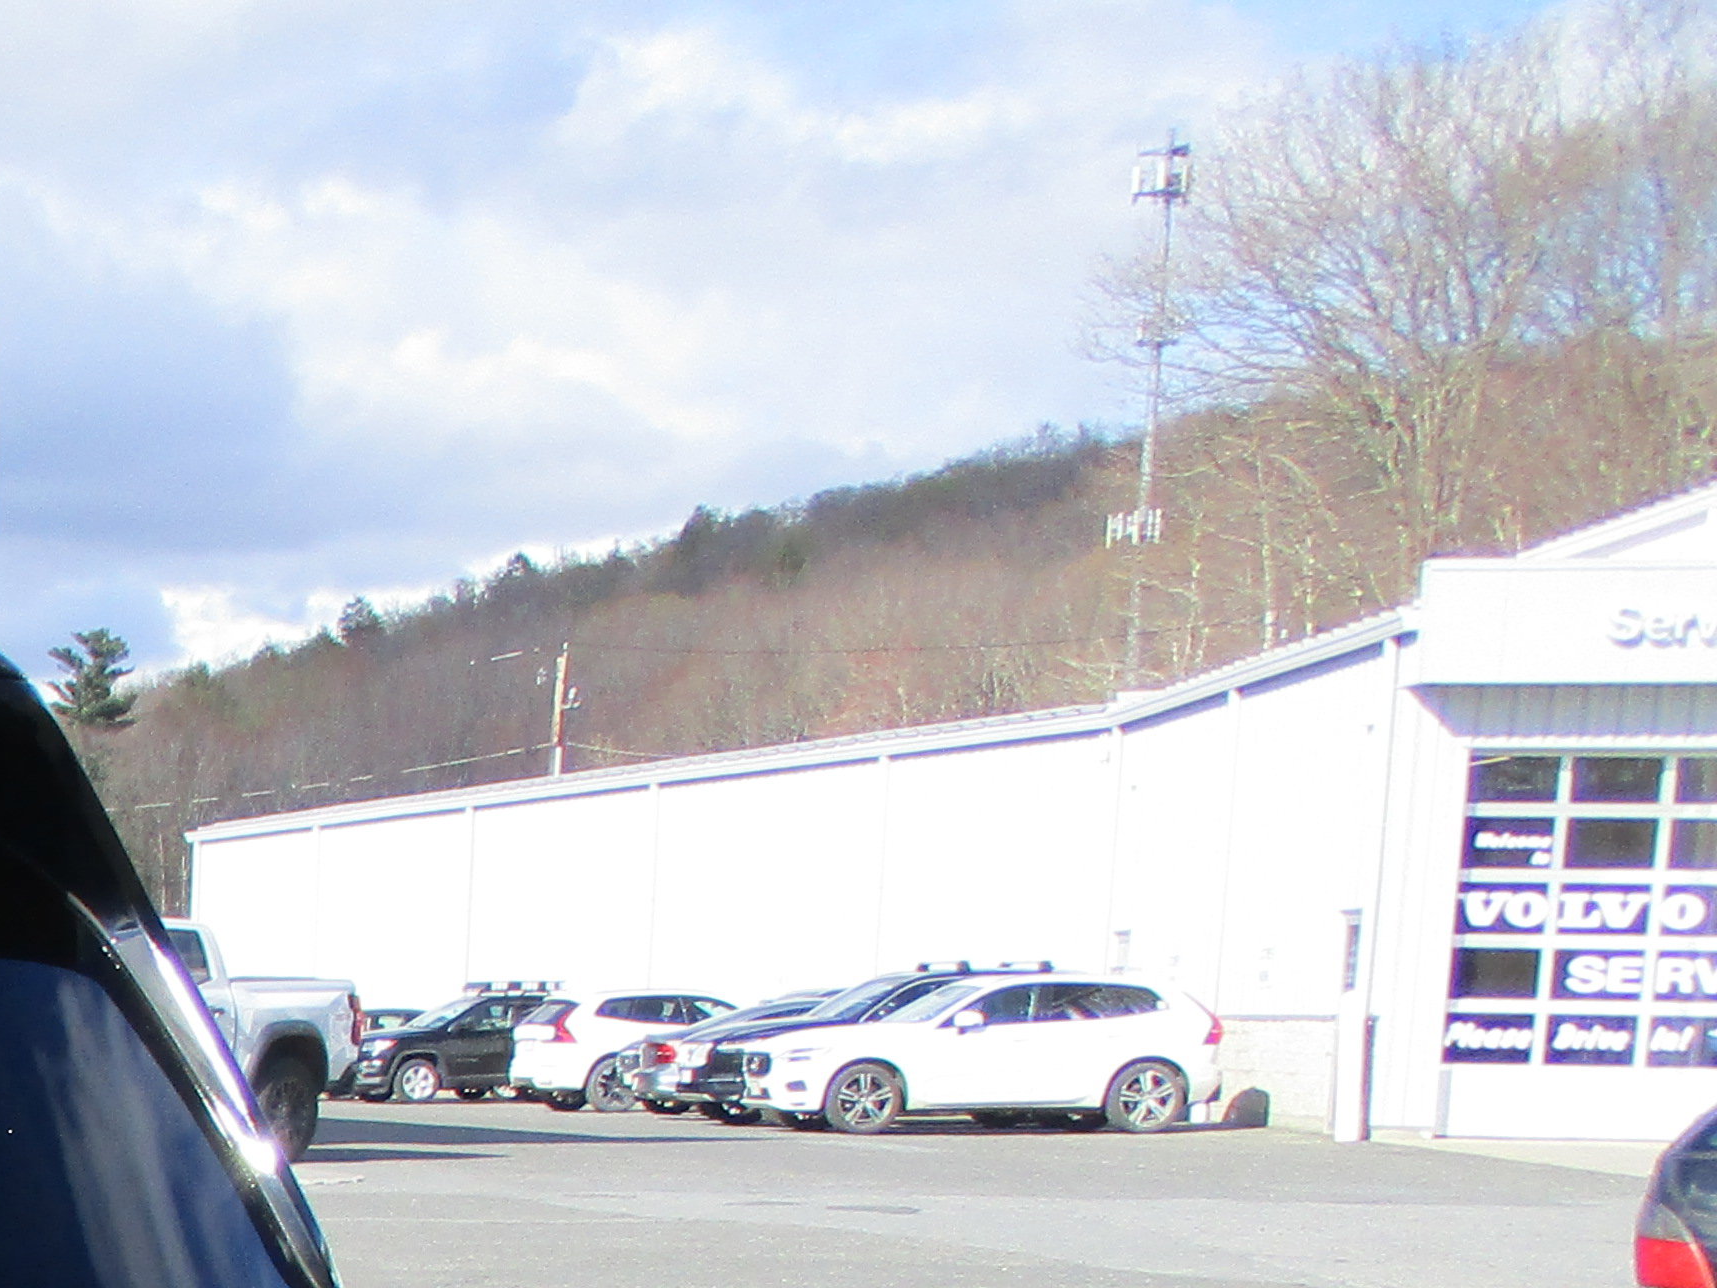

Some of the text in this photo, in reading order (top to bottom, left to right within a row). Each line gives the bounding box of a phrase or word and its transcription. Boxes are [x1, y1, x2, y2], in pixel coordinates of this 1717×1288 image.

[1464, 890, 1707, 931] VOLVO
[1445, 1021, 1533, 1050] Please
[1551, 1023, 1631, 1052] Drive
